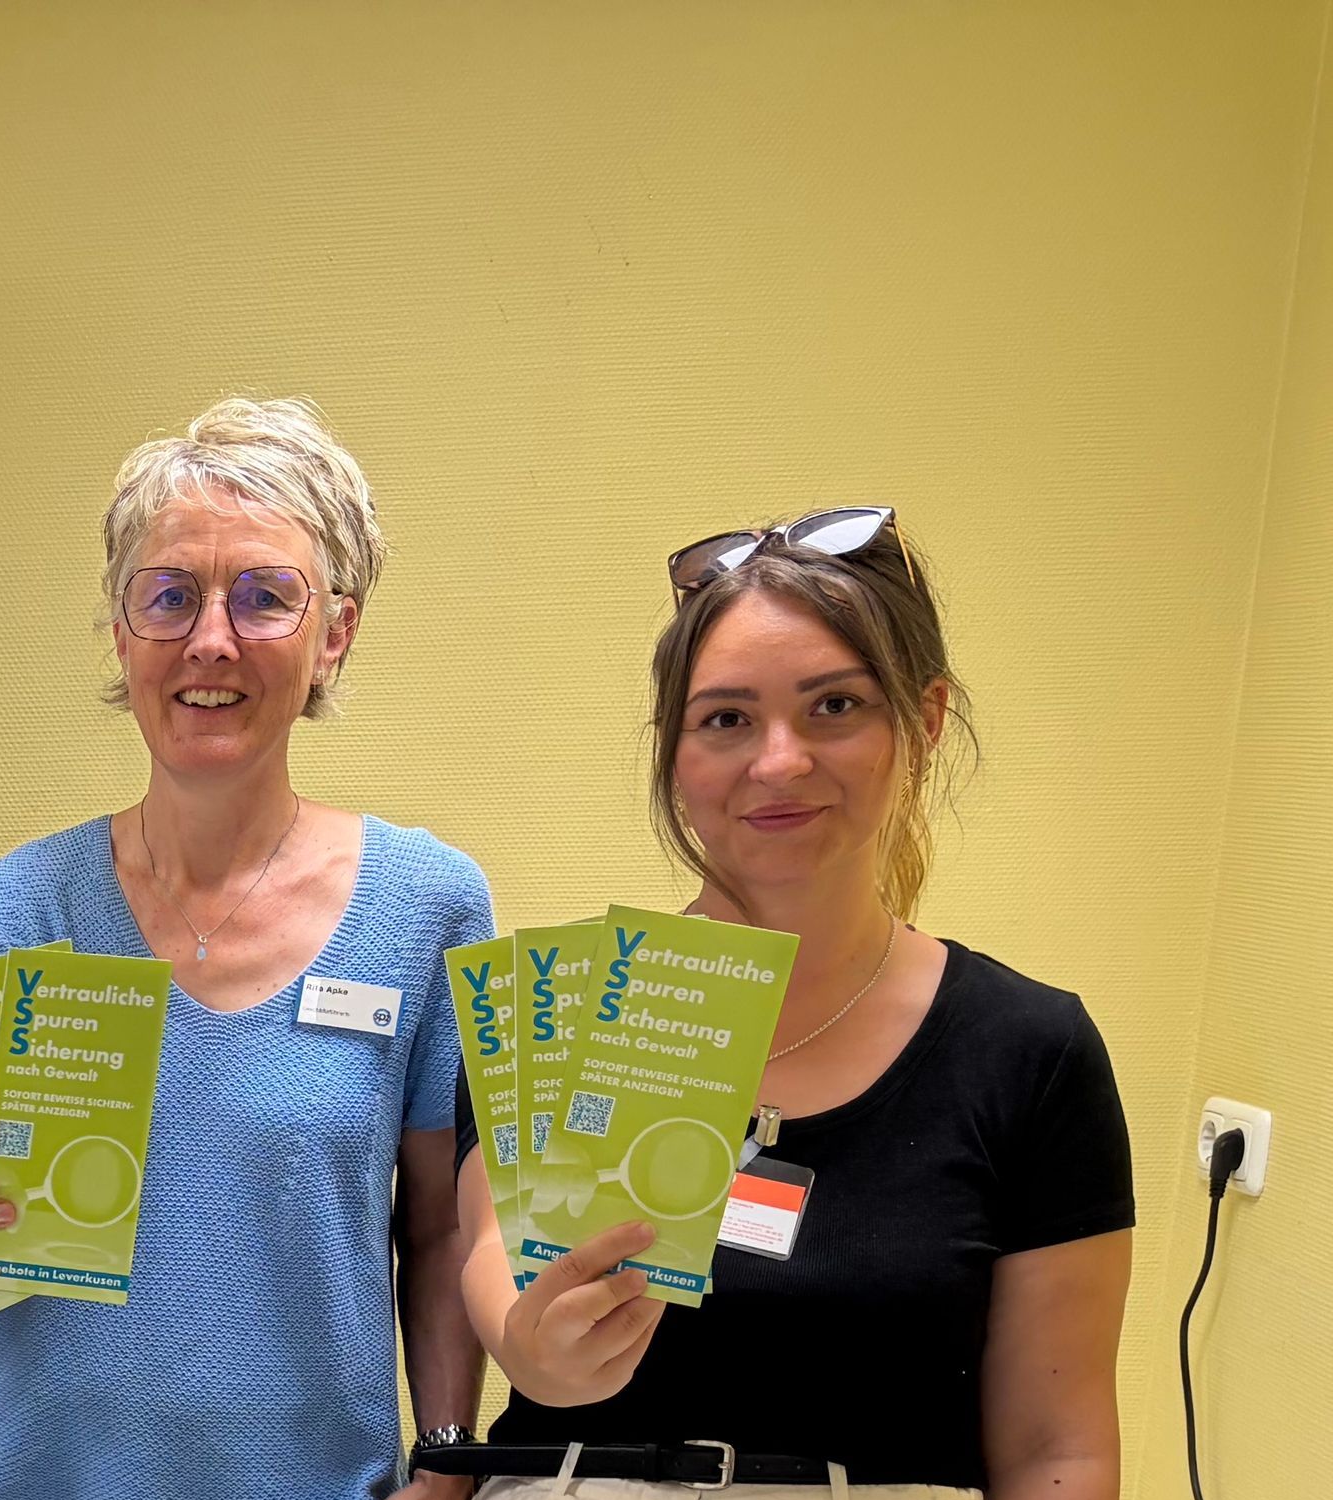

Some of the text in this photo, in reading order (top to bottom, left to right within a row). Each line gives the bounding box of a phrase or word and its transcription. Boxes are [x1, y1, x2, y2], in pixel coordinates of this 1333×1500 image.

[615, 927, 776, 985] Vertrauliche
[17, 969, 155, 1009] Vertrauliche
[605, 960, 705, 1004] Spuren
[14, 998, 98, 1031] Spuren
[596, 992, 732, 1048] Sicherung
[9, 1028, 125, 1070] Sicherung
[590, 1030, 698, 1060] nach Gewalt
[6, 1062, 99, 1082] nach Gewalt
[579, 1070, 684, 1099] SPÄTER ANZEIGEN
[583, 1058, 629, 1074] SOFORT
[631, 1066, 680, 1085] BEWEISE
[1, 1100, 90, 1119] SPÄTER ANZEIGEN
[4, 1089, 42, 1101] SOFORT
[44, 1093, 85, 1106] BEWEISE
[38, 1268, 50, 1278] in
[53, 1268, 121, 1287] Leverkusen
